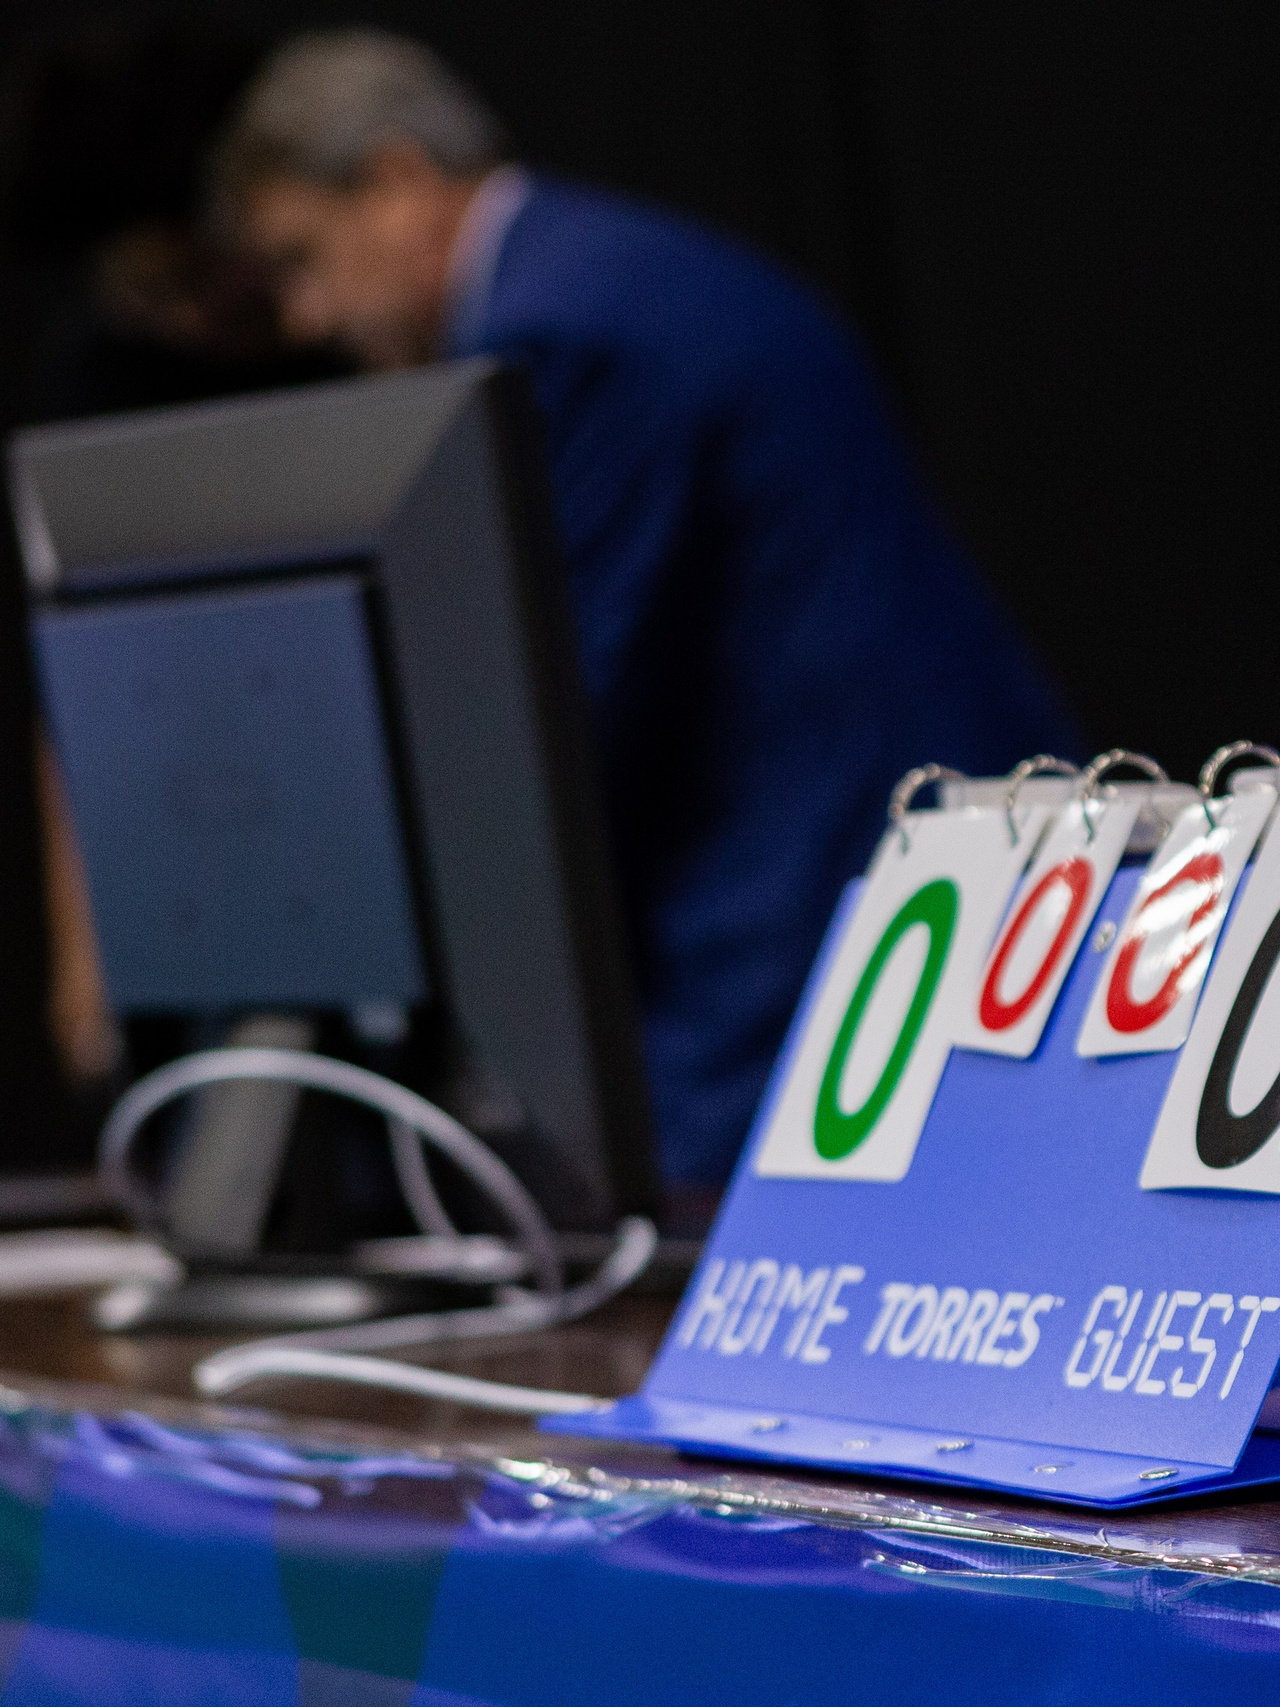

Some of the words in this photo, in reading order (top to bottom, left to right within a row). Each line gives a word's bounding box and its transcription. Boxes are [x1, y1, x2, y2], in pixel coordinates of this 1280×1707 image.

[813, 877, 961, 1161] 0
[978, 857, 1095, 1033] 0
[1106, 852, 1224, 1034] 0
[680, 1257, 866, 1364] HOME
[864, 1281, 1056, 1368] TORRES
